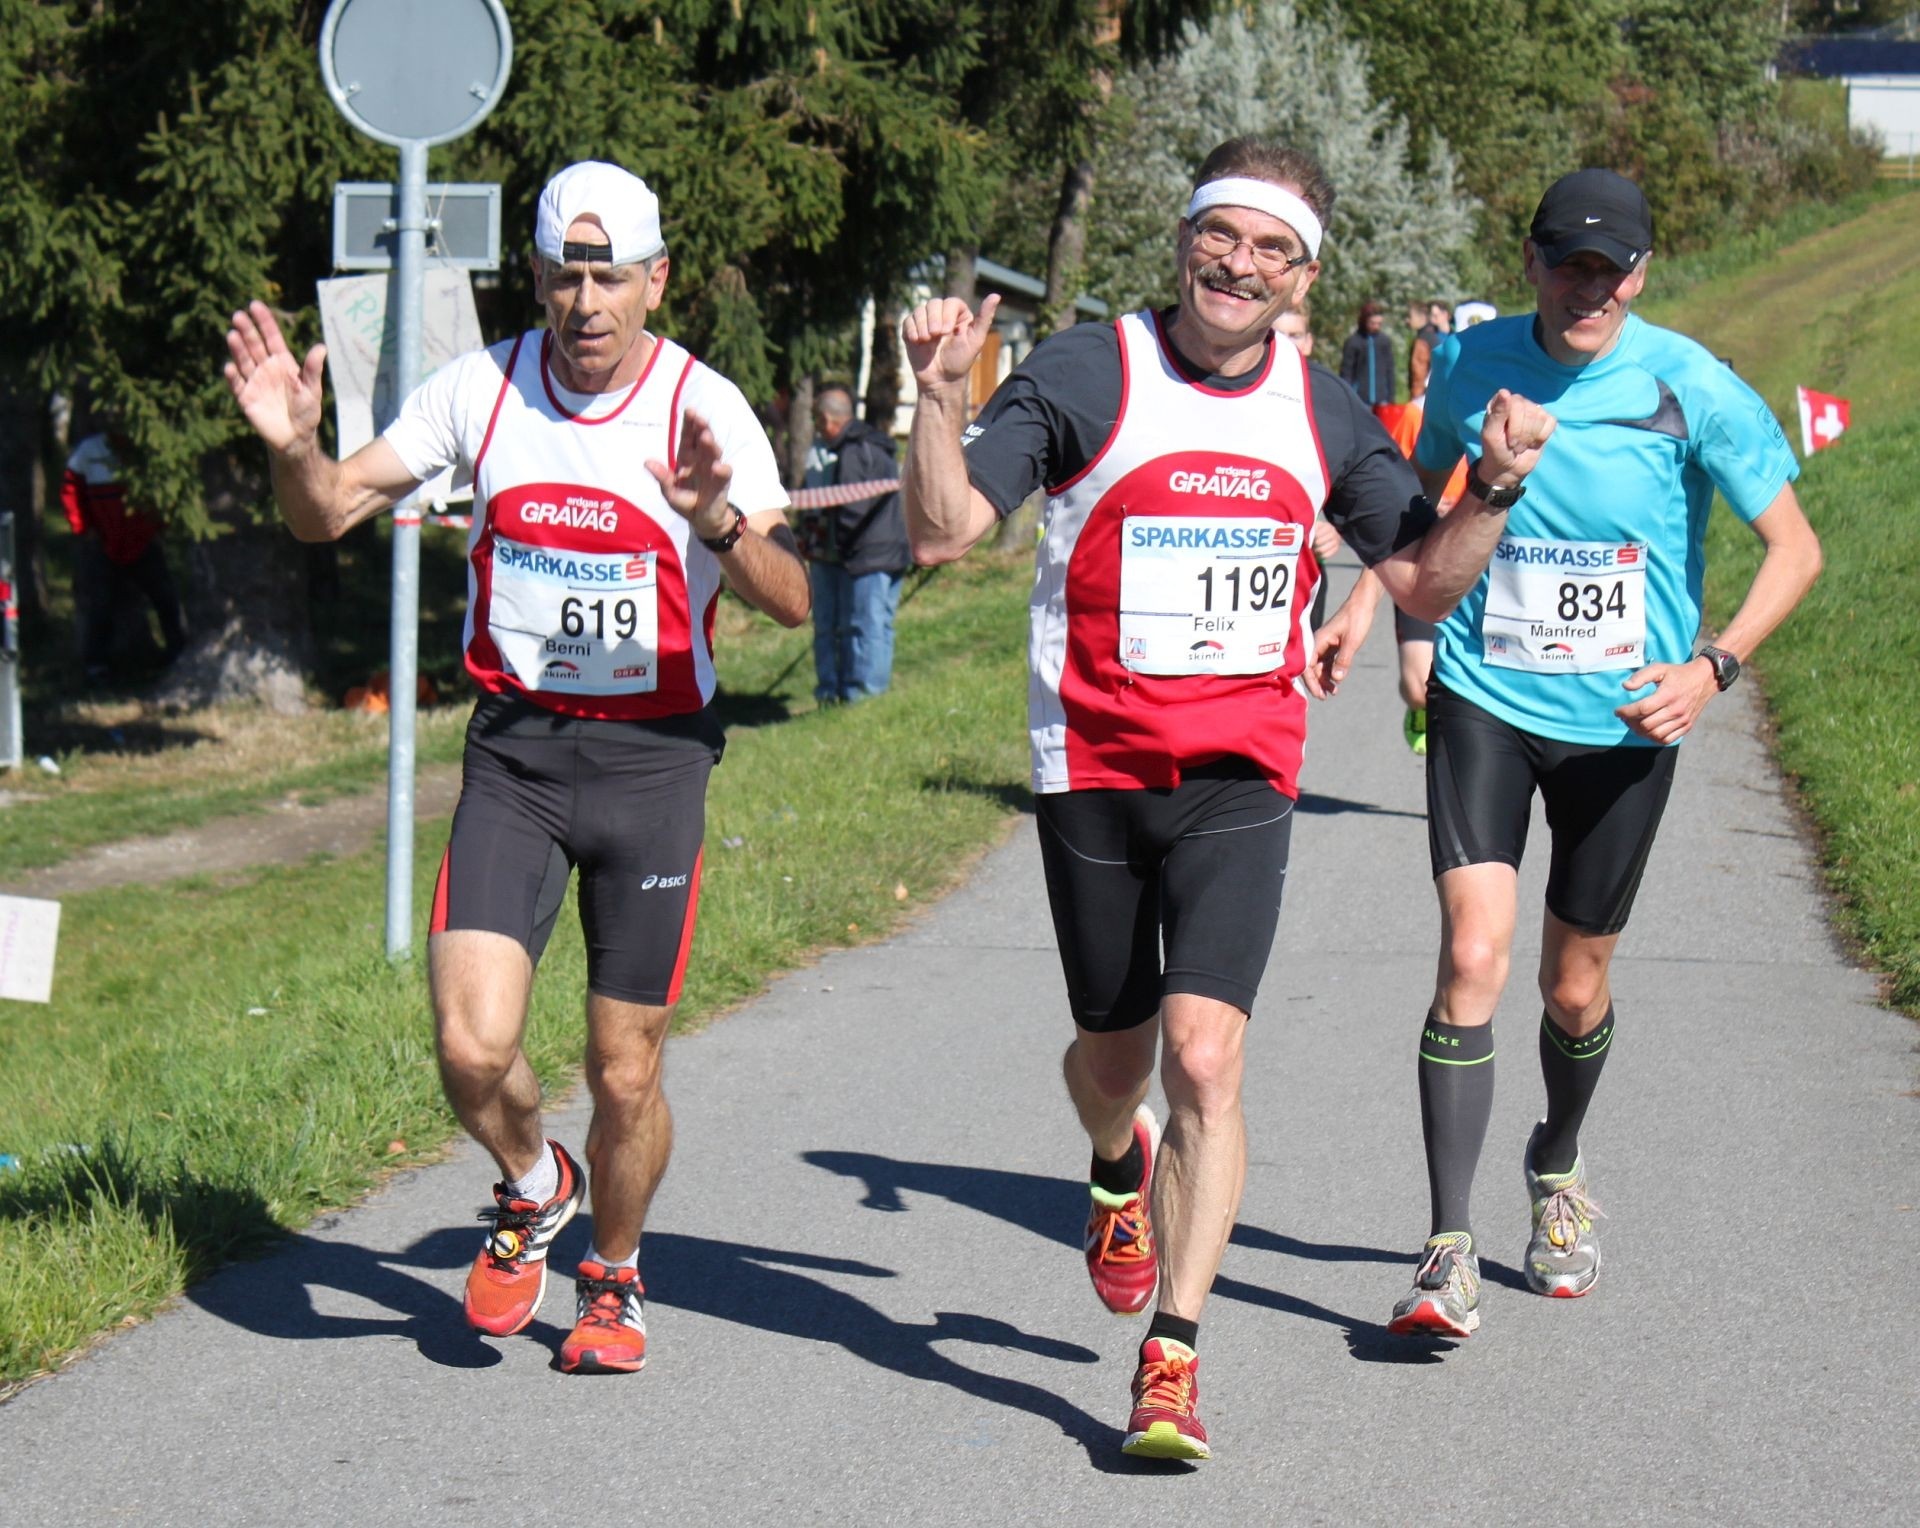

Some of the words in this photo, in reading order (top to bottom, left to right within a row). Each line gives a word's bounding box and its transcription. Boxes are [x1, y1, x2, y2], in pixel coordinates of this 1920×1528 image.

[1215, 466, 1251, 478] erdgas
[1169, 471, 1271, 501] GRAVAG
[566, 496, 599, 509] erdgas
[520, 501, 618, 533] GRAVAG
[1131, 527, 1271, 548] SPARKASSE
[500, 546, 622, 582] SPARKASSE
[1495, 543, 1614, 567] SPARKASSE
[1197, 563, 1290, 612] 1192
[1557, 580, 1627, 622] 834
[560, 597, 638, 639] 619
[1193, 616, 1236, 632] Felix
[1530, 624, 1597, 638] Manfred
[545, 639, 591, 657] Berni
[1188, 652, 1226, 661] skinfit
[1540, 652, 1576, 661] skinfit
[544, 671, 581, 680] skinfit
